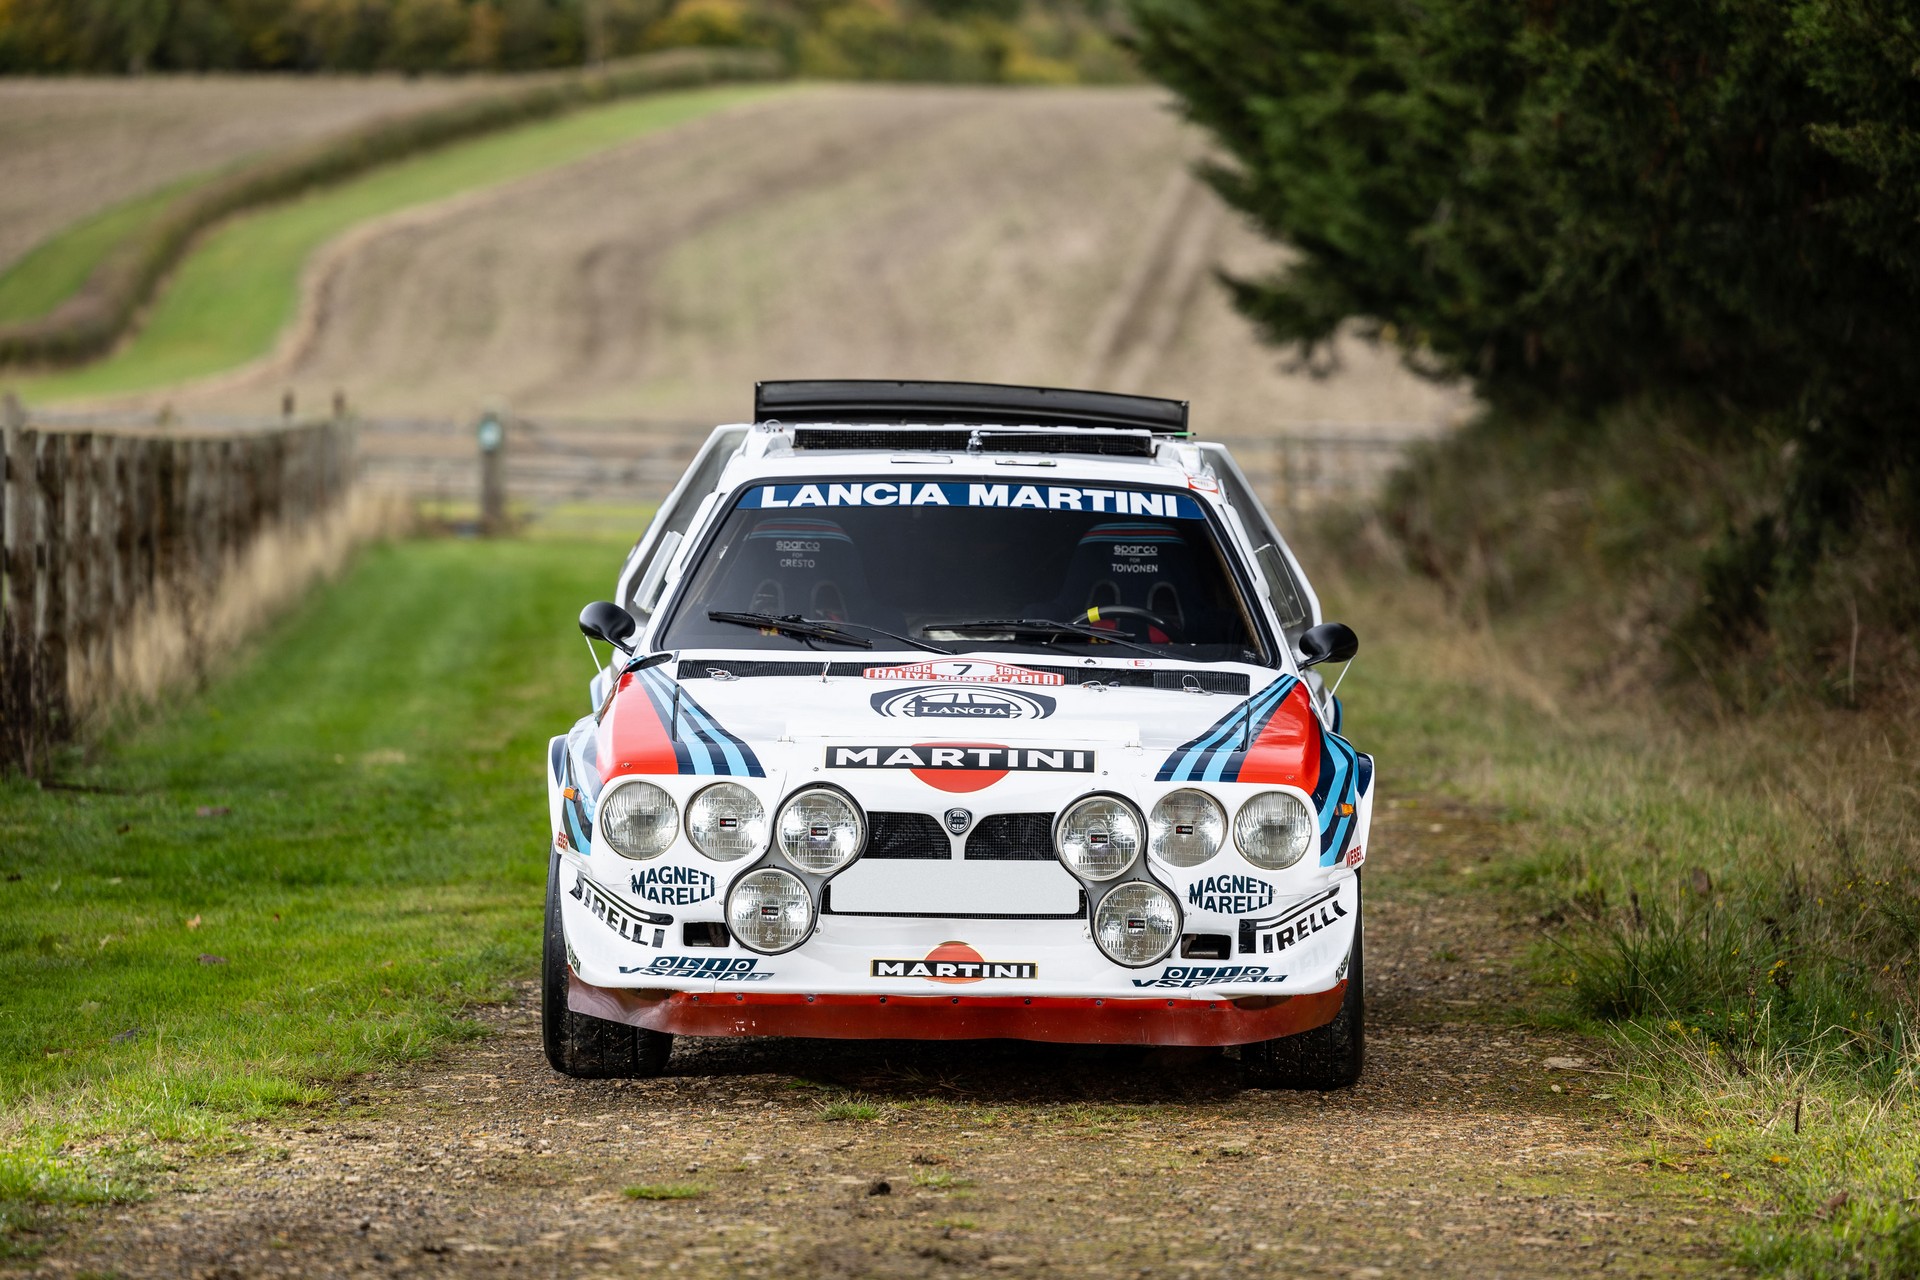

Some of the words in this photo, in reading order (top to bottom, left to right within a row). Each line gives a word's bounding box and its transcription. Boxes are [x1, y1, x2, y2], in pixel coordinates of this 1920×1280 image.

[761, 483, 950, 508] LANCIA
[969, 484, 1178, 518] MARTINI
[776, 540, 820, 551] sparco
[1114, 545, 1158, 556] sparco
[780, 559, 816, 568] CRESTO
[1112, 563, 1159, 573] TOIVONEN
[875, 670, 930, 680] RALLYE
[953, 664, 972, 676] 7
[922, 706, 1008, 716] LANCIA
[835, 748, 1084, 769] MARTINI
[631, 866, 715, 887] MAGNETI
[1189, 875, 1274, 896] MAGNETI
[632, 880, 715, 905] MARELLI
[1189, 893, 1274, 914] MARELLI
[650, 956, 757, 971] OLIO
[878, 963, 1030, 978] MARTINI
[1162, 967, 1258, 979] OLIO
